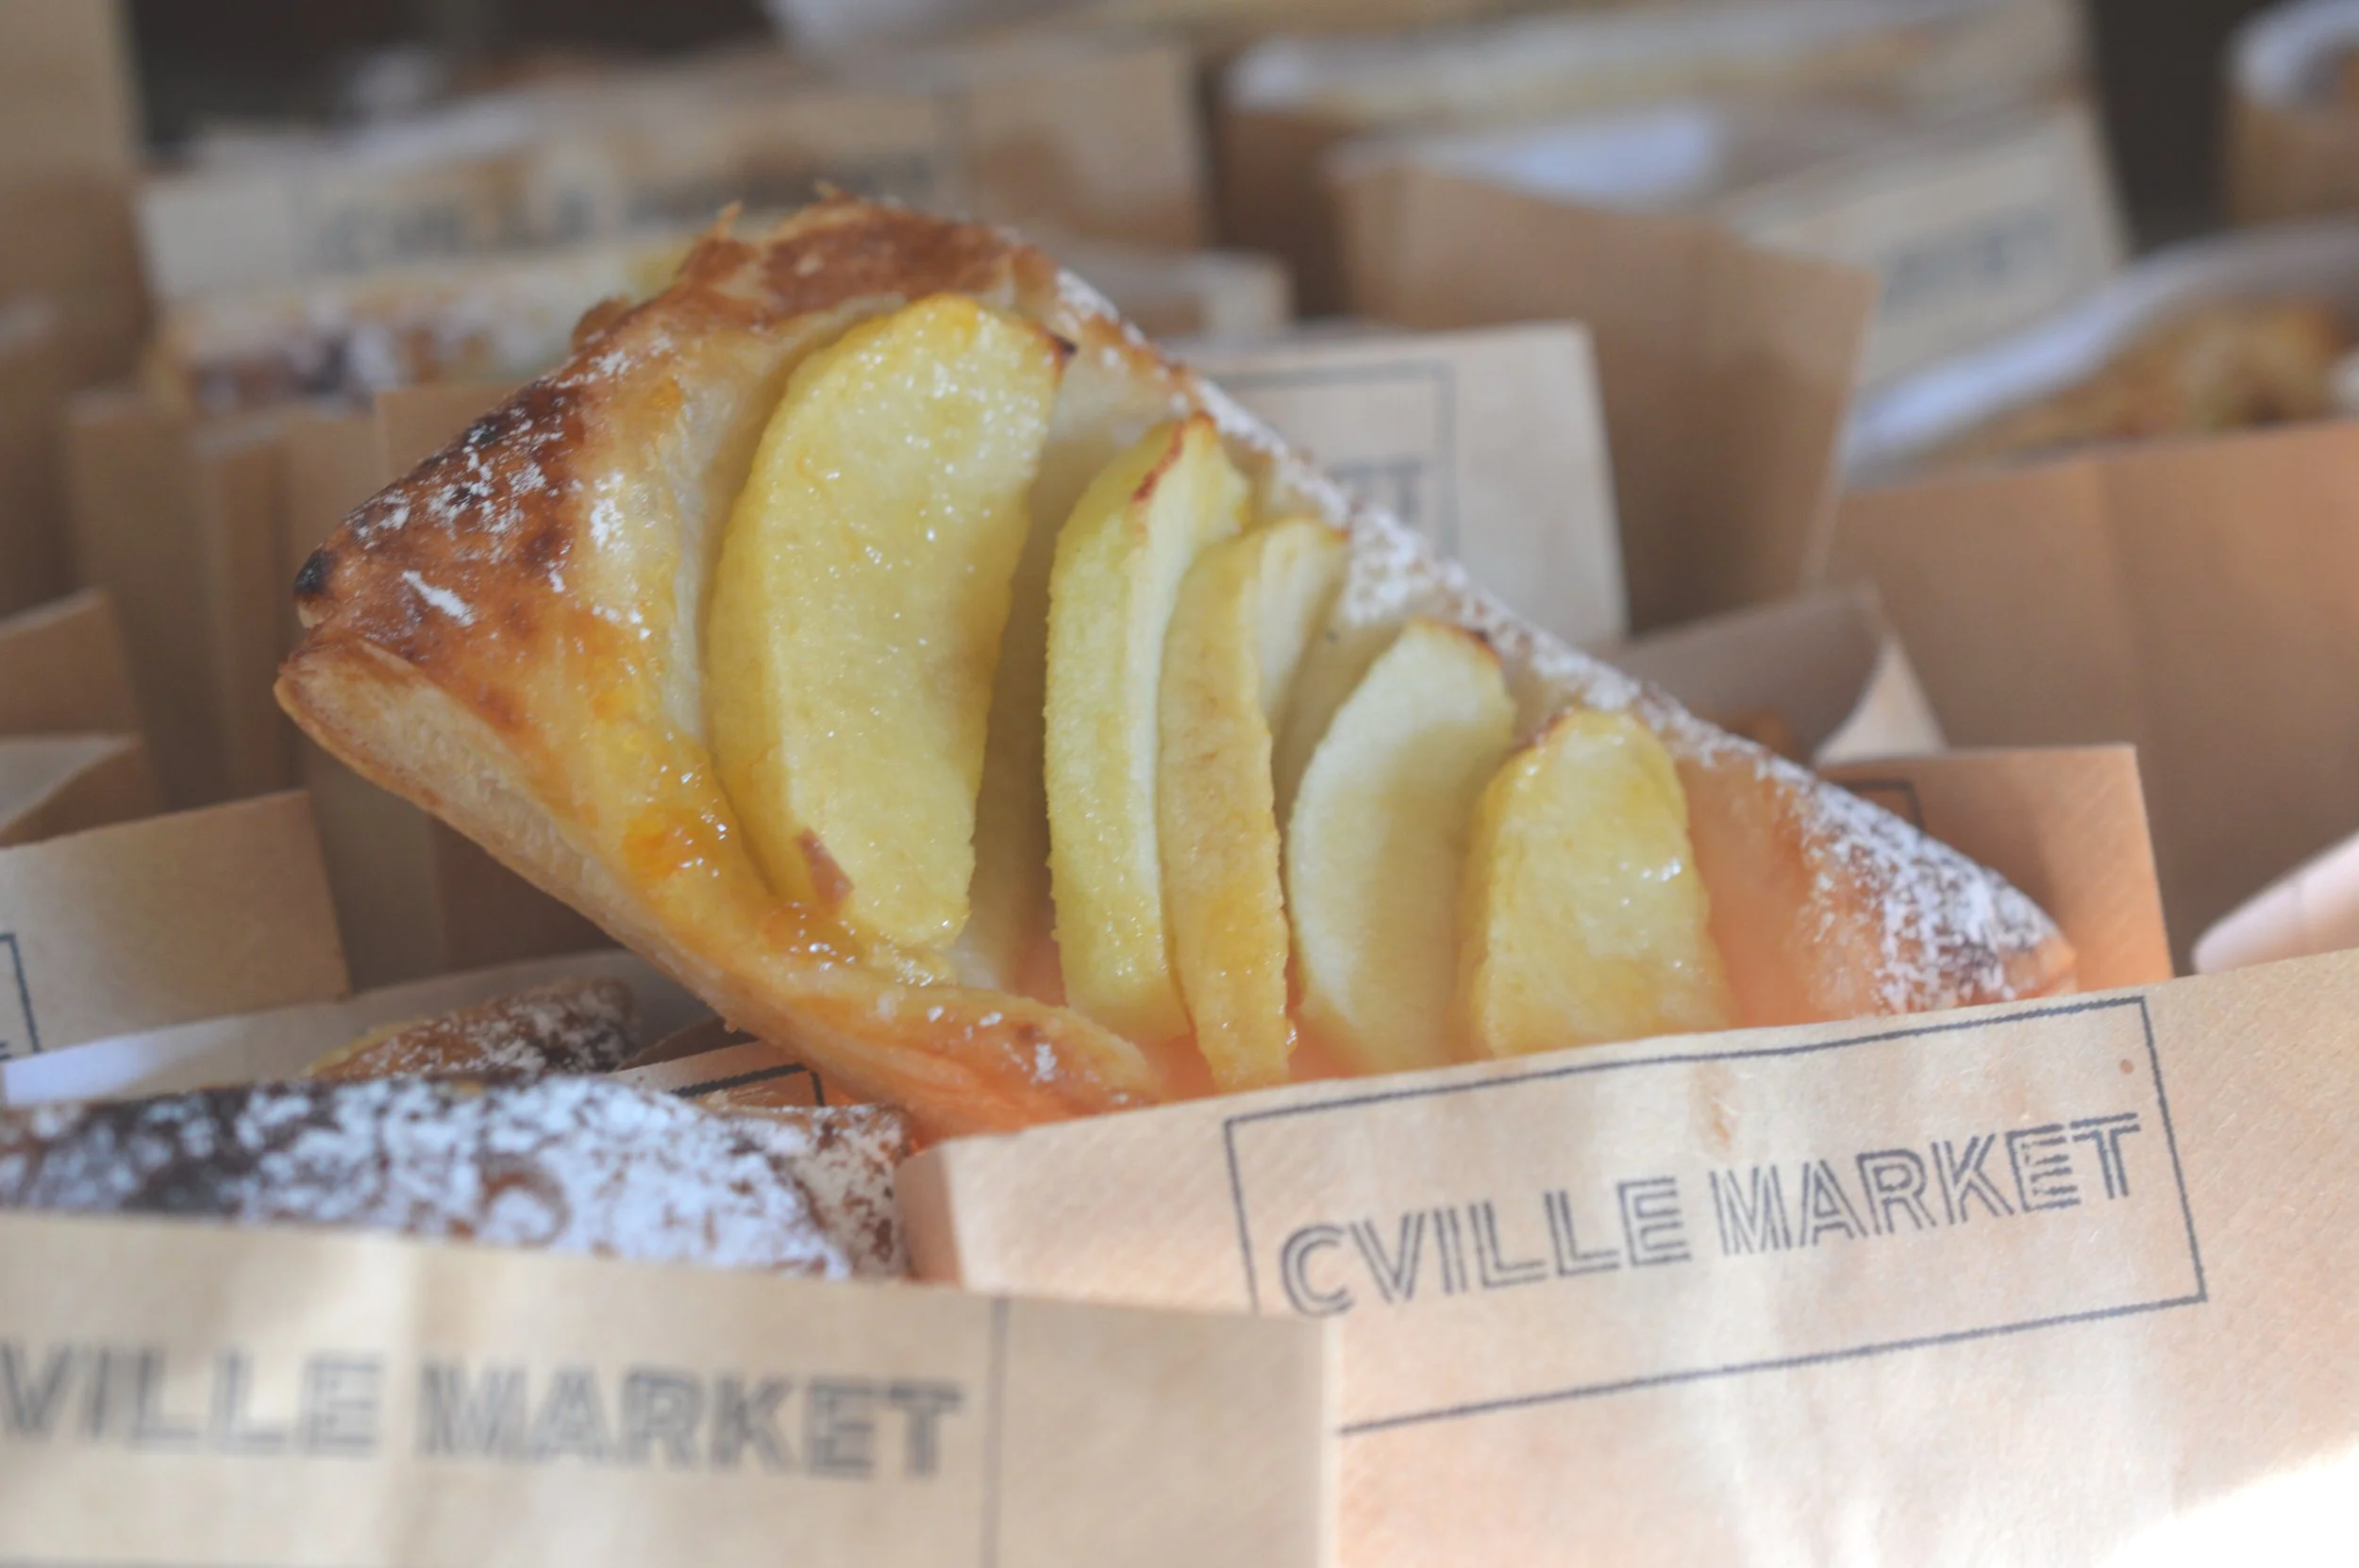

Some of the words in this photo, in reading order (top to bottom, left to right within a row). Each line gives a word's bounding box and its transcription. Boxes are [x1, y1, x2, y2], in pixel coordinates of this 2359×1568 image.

[1280, 1176, 1692, 1318] CVILLE
[1708, 1111, 2141, 1256] MARKET
[415, 1357, 964, 1479] MARKET
